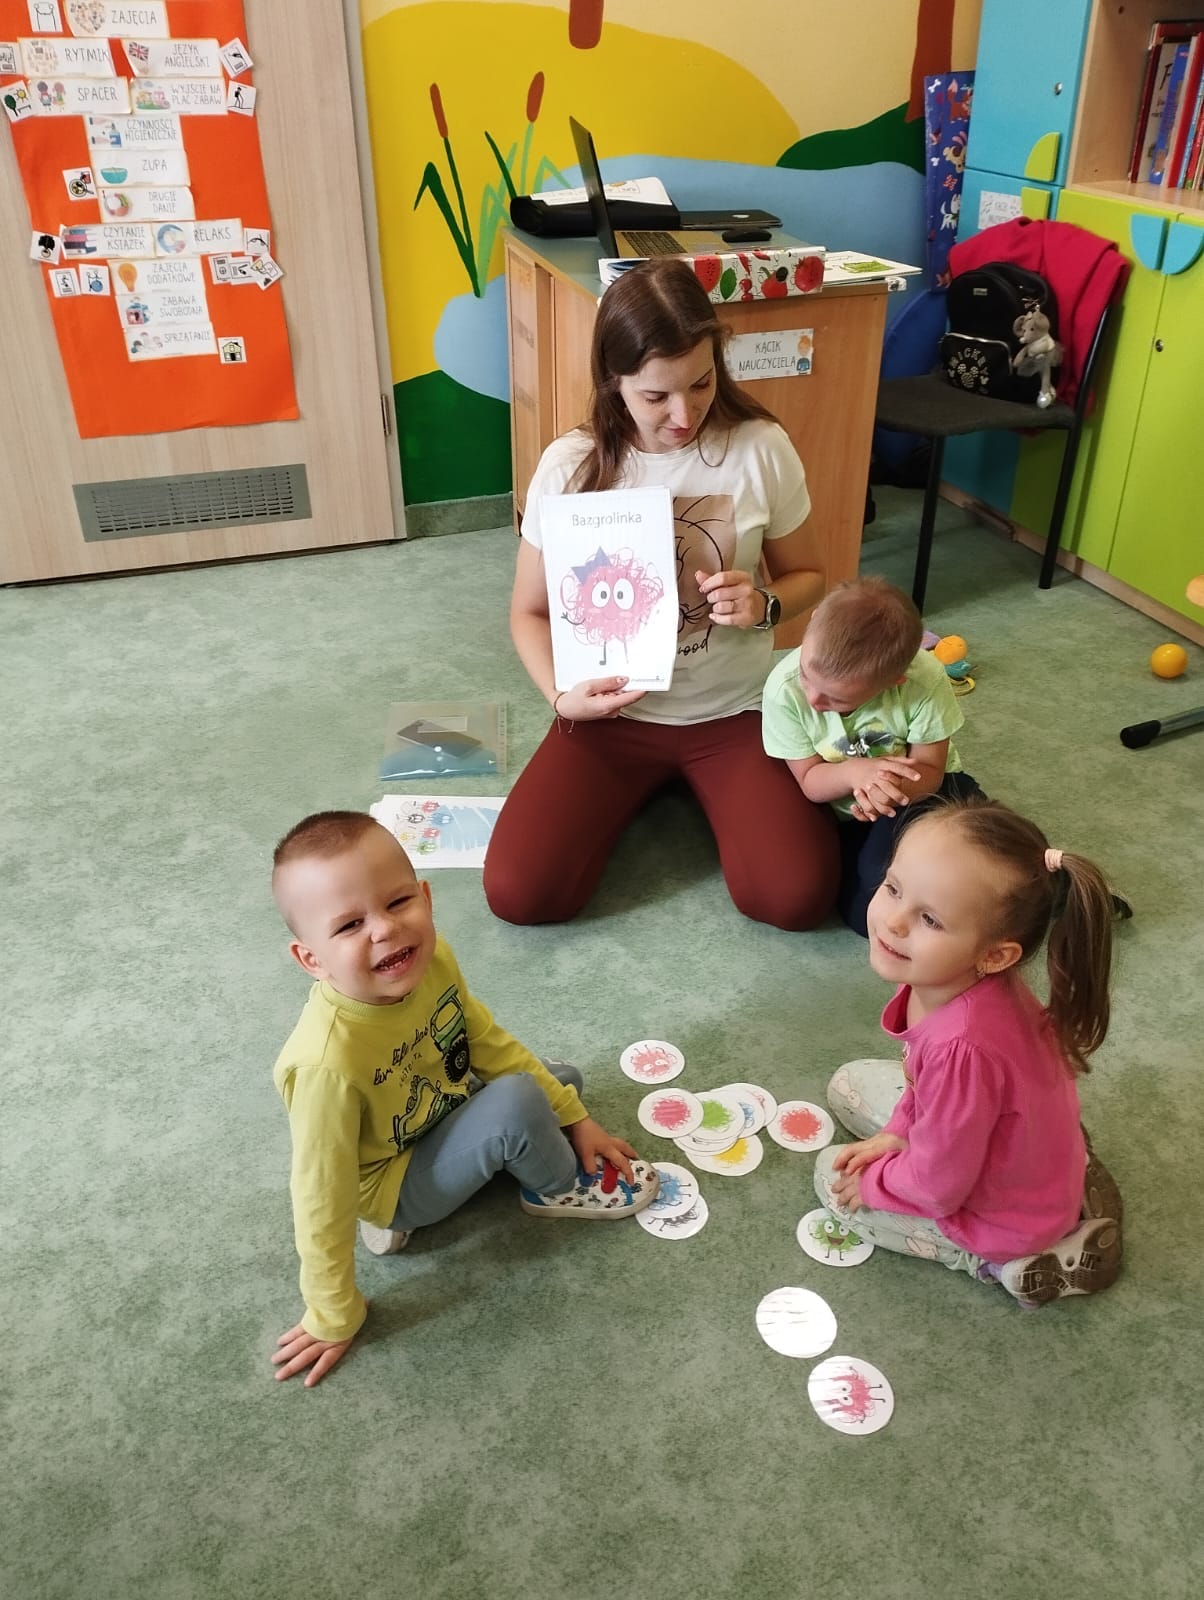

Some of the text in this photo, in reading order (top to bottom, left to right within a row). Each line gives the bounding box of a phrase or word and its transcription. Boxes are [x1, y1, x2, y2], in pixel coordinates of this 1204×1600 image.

[111, 9, 157, 26] ZAJĘCIA
[164, 55, 210, 68] ANGIELSKI
[78, 86, 118, 102] SPACER
[194, 94, 222, 105] ZABAW
[125, 129, 177, 142] HIGIENICZNE
[142, 159, 168, 171] ZUPA
[103, 226, 145, 238] CZYTANIE
[194, 227, 232, 242] RELAKS
[755, 340, 782, 354] KĄCIK
[738, 356, 796, 372] NAUCZYCIELA
[571, 511, 643, 529] Bazgrolinka
